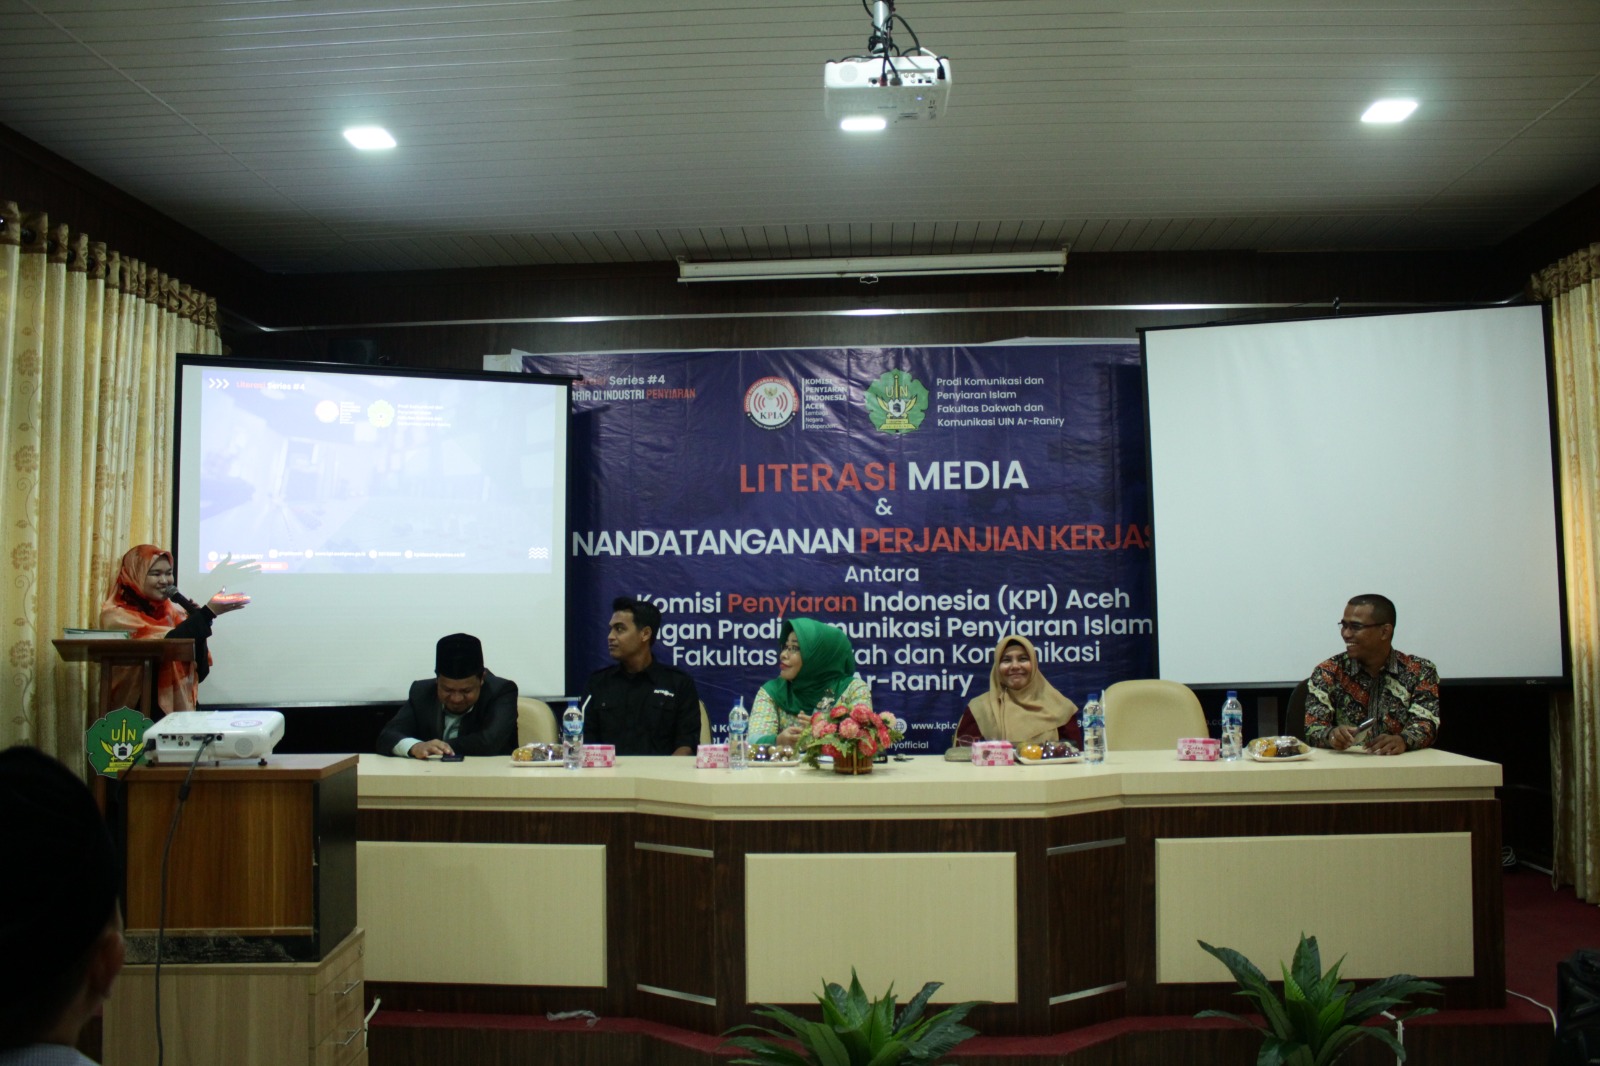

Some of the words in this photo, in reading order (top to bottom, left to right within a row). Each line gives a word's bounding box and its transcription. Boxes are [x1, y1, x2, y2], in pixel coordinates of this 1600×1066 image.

[609, 374, 645, 386] Series
[647, 374, 666, 385] #4
[936, 377, 962, 387] Prodi
[964, 376, 1022, 386] Komunikasi
[1024, 376, 1045, 385] dan
[572, 390, 592, 401] ARIR
[593, 390, 602, 401] DI
[604, 389, 645, 400] INDUSTRI
[646, 388, 696, 399] PENYIARAN
[936, 390, 987, 402] Penyiaran
[989, 390, 1017, 399] Islam
[760, 411, 784, 420] KPIA
[937, 404, 979, 413] Fakultas
[981, 403, 1022, 413] Dakwah
[1024, 403, 1044, 412] dan
[937, 417, 996, 427] Komunikasi
[998, 417, 1015, 426] UIN
[1017, 416, 1065, 428] Ar-Raniry
[740, 462, 896, 493] LITERASI
[908, 460, 1030, 491] MEDIA
[875, 497, 893, 516] &
[572, 528, 855, 557] NANDATANGANAN
[860, 525, 1047, 554] PERJANJIAN
[845, 565, 919, 582] Antara
[728, 590, 857, 619] Penyiaran
[863, 589, 990, 612] Indonesia
[998, 583, 1058, 615] (KPI)
[1065, 587, 1130, 610] Aceh
[656, 623, 711, 647] gan
[719, 616, 782, 640] Prodi
[826, 616, 941, 639] unikasi
[947, 613, 1077, 643] Penyiaran
[1084, 614, 1153, 636] Islam
[673, 644, 778, 667] Fakultas
[895, 643, 945, 666] dan
[952, 640, 1101, 664] Koikasi
[111, 725, 137, 742] UIN
